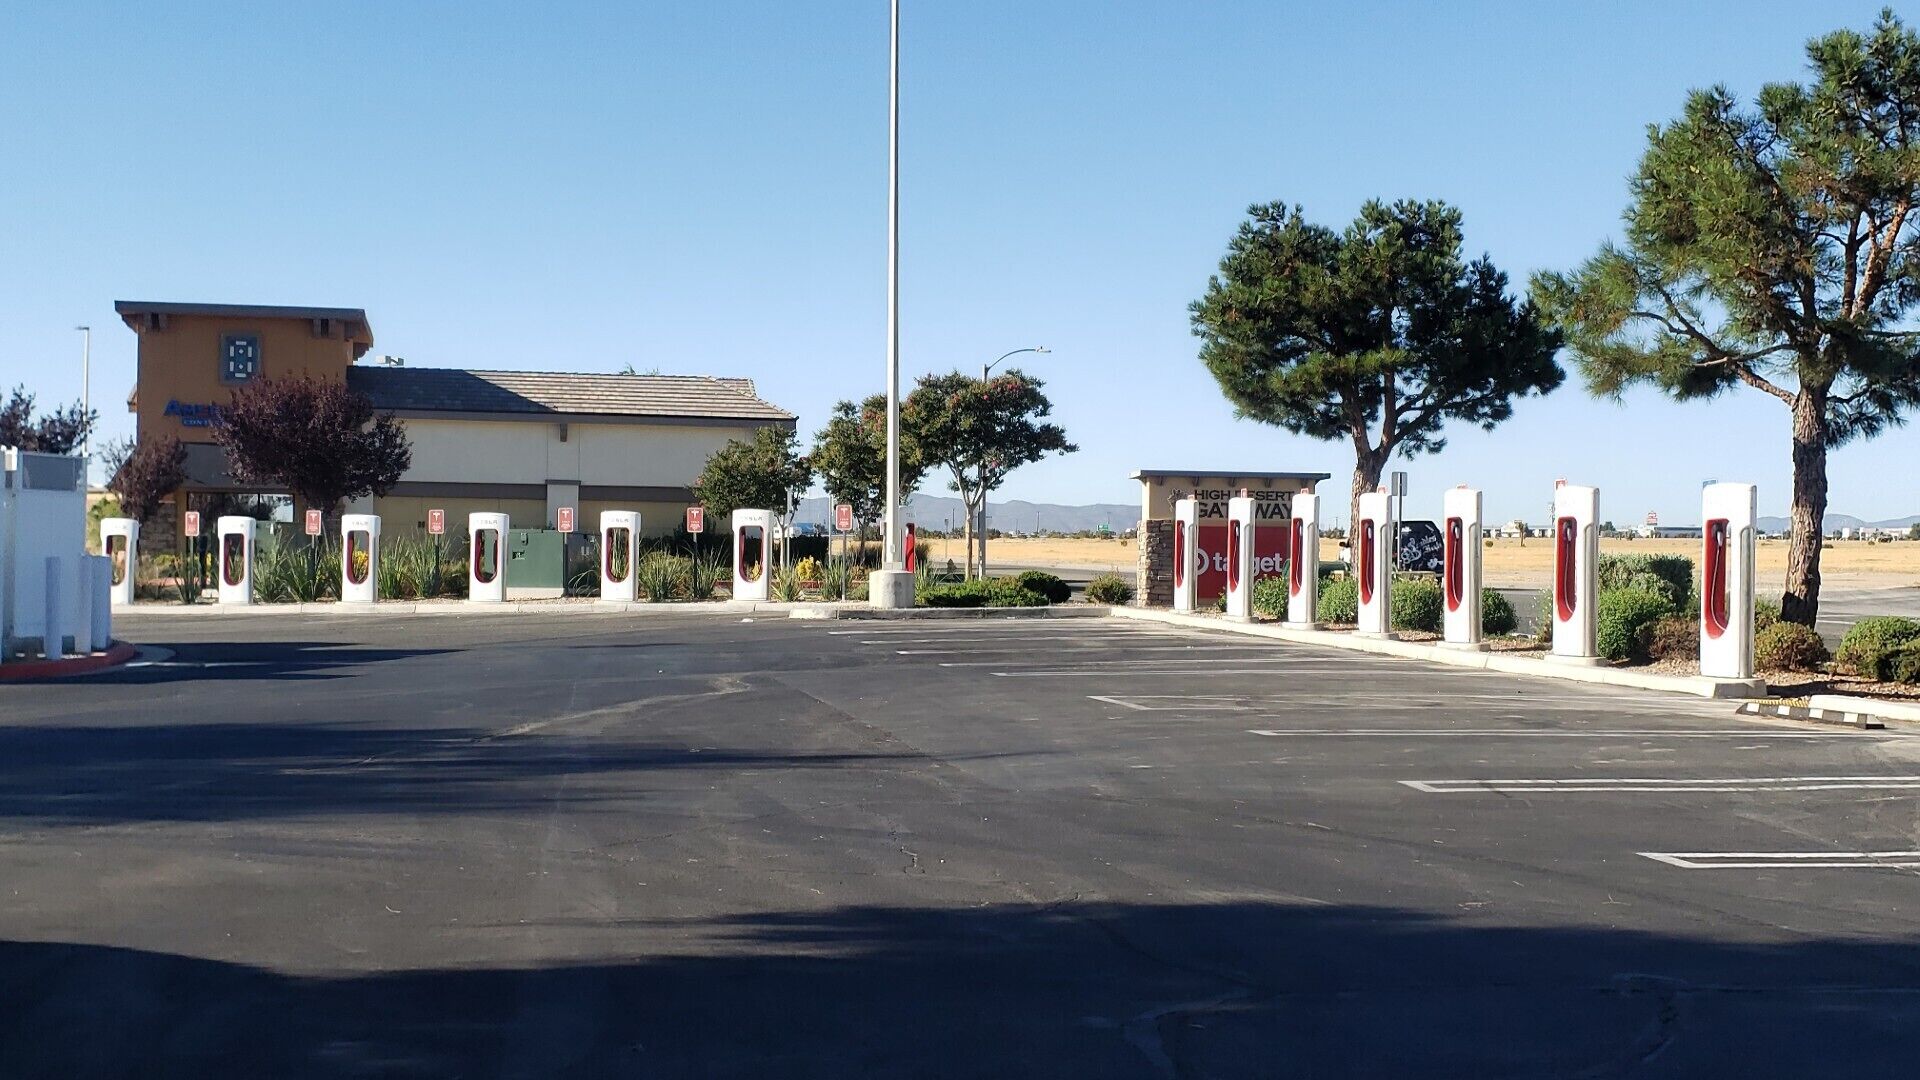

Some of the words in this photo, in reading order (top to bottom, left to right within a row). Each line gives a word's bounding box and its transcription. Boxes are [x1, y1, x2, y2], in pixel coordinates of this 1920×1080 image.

[1195, 489, 1230, 501] HIGH
[1199, 502, 1292, 520] GATWAY
[1213, 552, 1283, 577] taget
